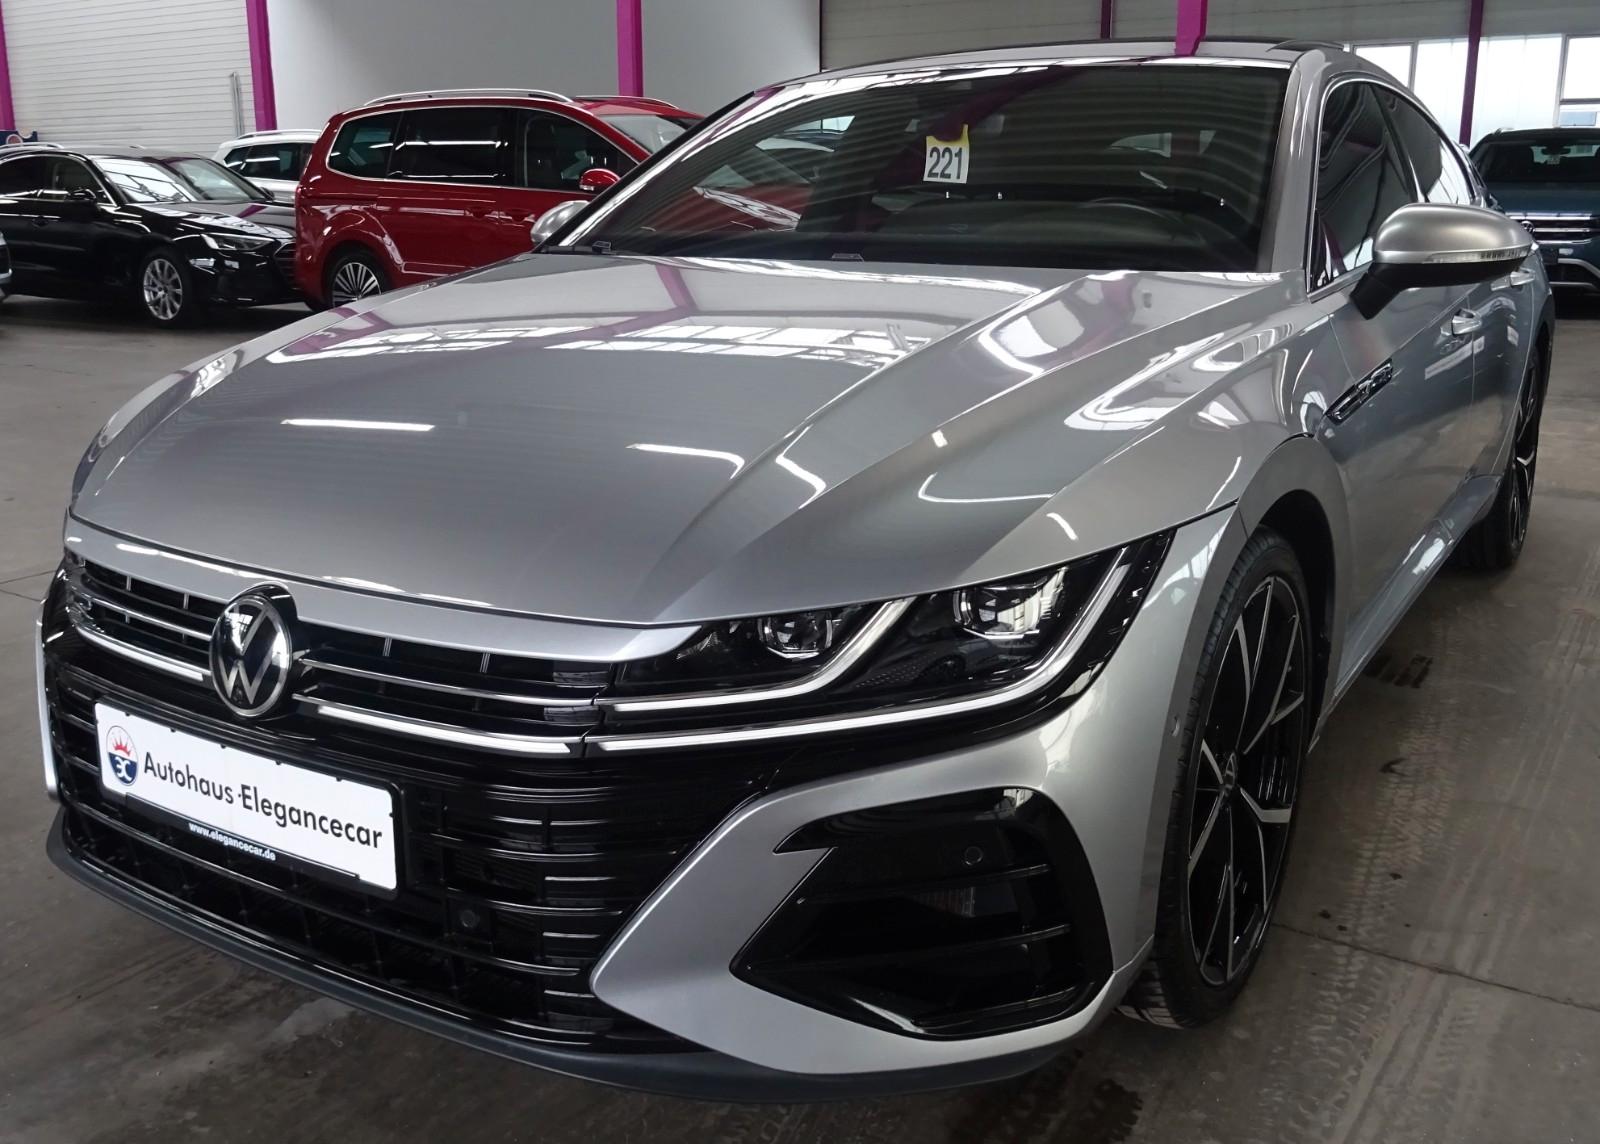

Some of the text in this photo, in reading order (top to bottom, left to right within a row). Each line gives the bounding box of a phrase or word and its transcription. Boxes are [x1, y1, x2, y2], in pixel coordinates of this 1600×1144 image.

[927, 146, 963, 180] 221
[144, 751, 382, 848] Autohaus Elegancecar
[188, 822, 276, 861] www.elegancecar.de
